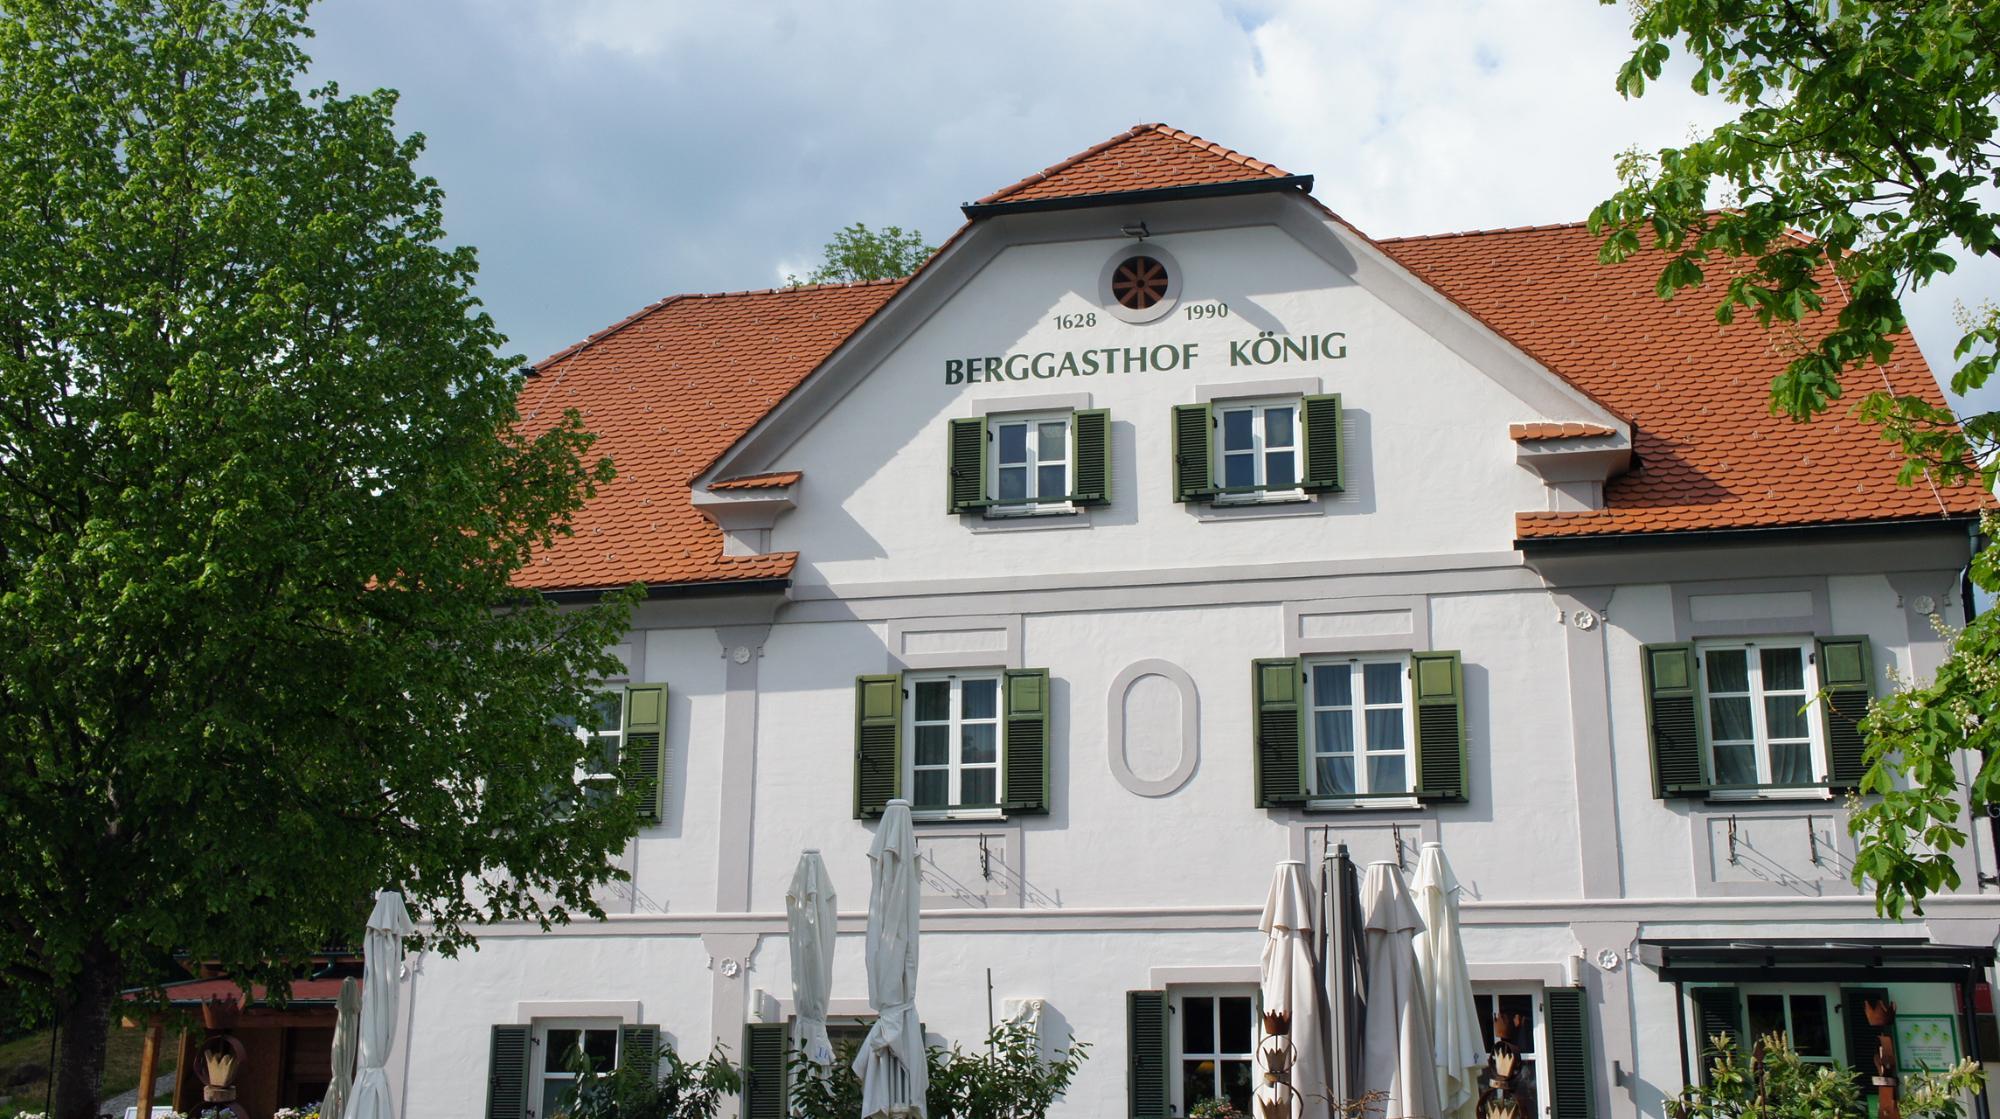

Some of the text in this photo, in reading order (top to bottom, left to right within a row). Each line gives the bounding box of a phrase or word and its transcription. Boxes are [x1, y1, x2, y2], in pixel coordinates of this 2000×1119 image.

[1053, 303, 1229, 330] 1628 1990
[945, 330, 1347, 385] BERGGASTHOF KÖNIG
